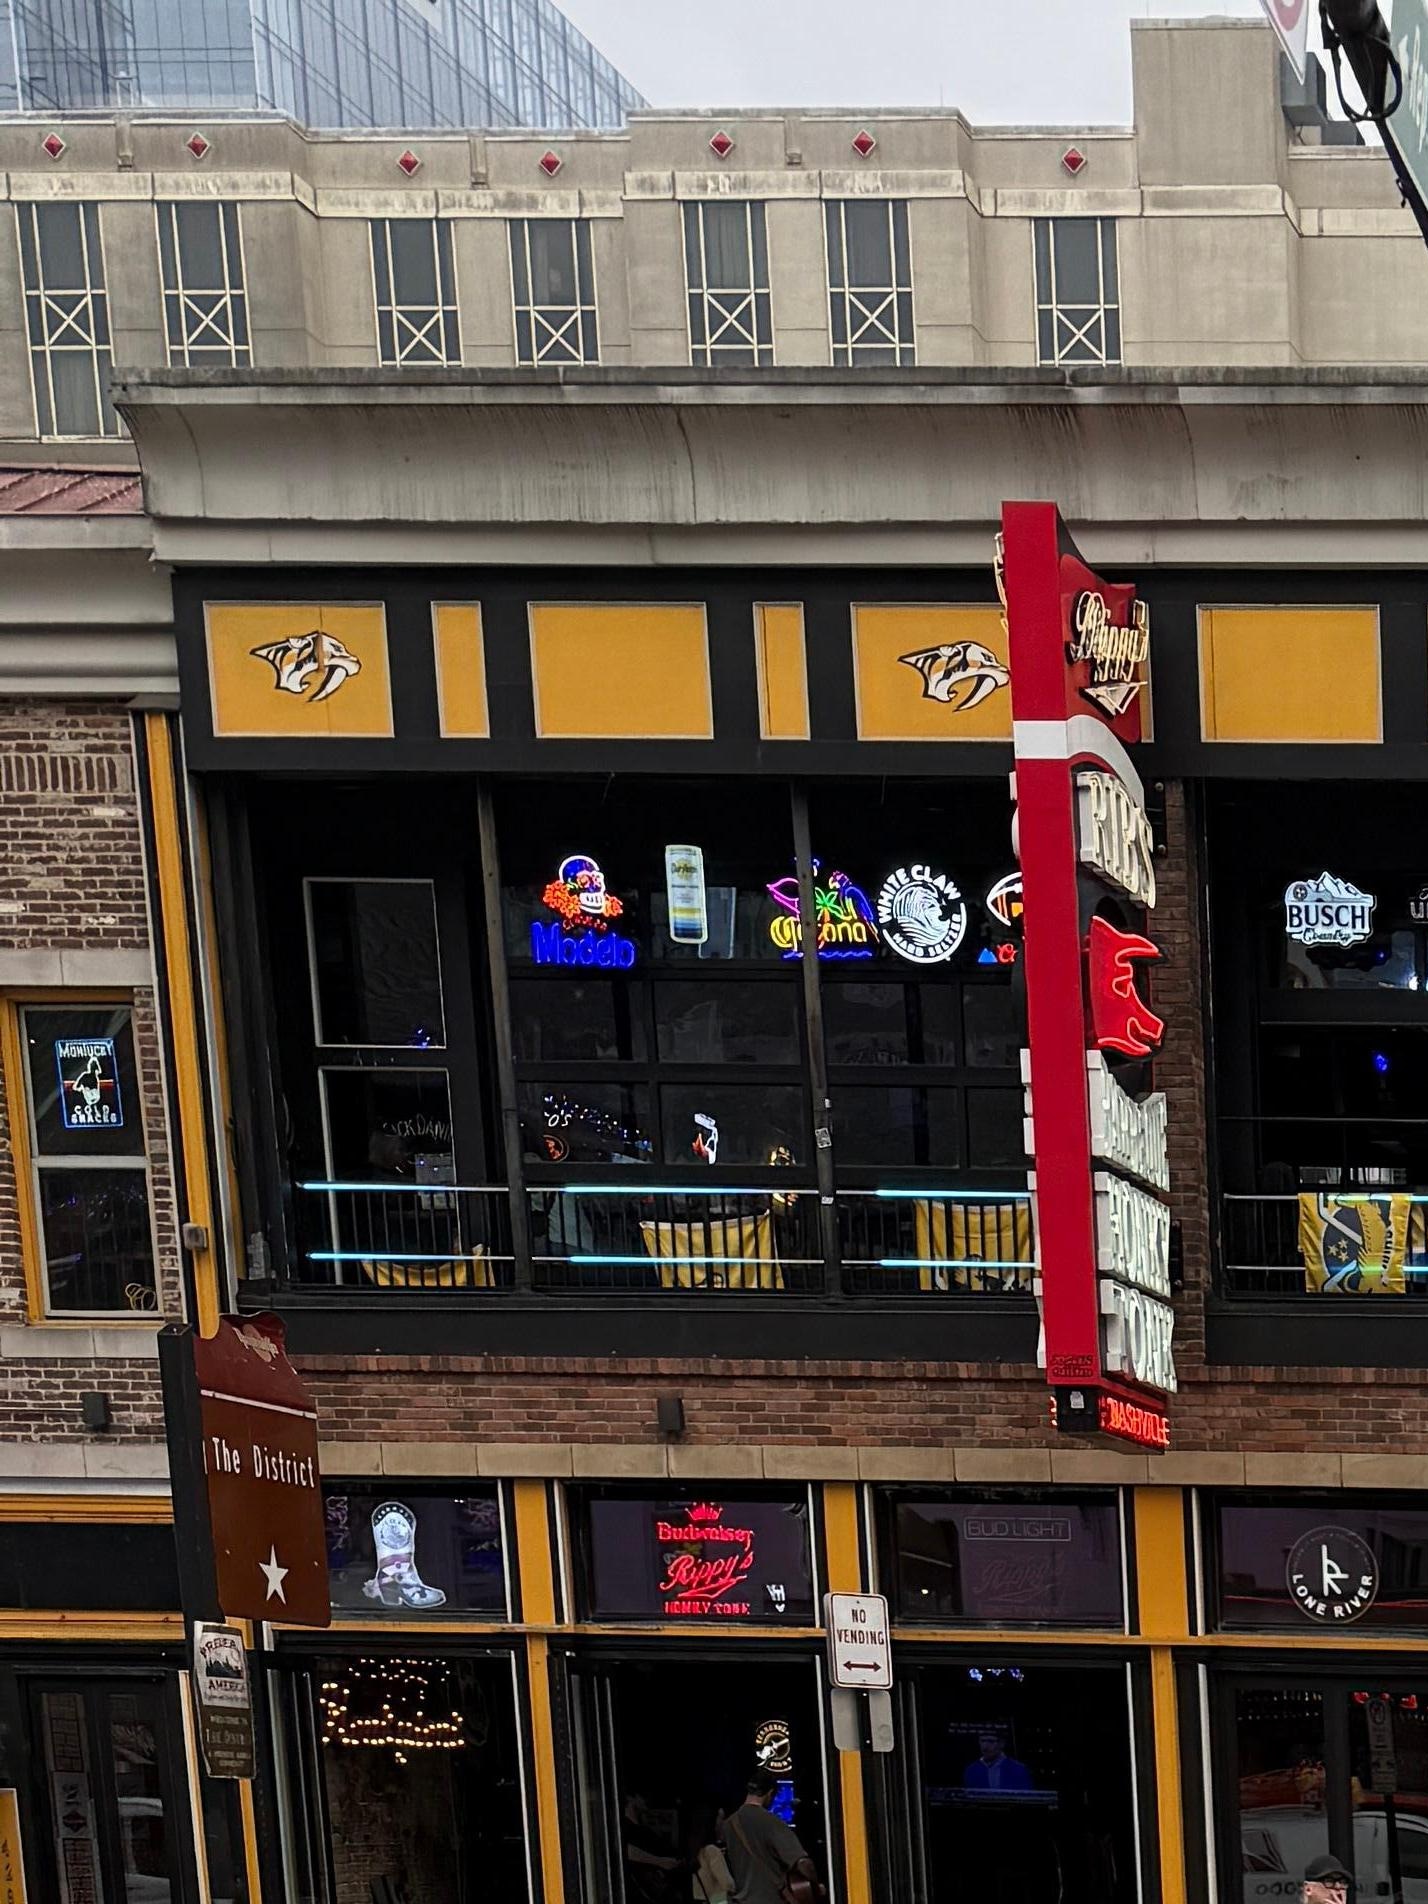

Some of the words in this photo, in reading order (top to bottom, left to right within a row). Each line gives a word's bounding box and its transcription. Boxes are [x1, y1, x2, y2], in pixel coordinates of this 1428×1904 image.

[878, 868, 909, 923] WHITE
[911, 864, 961, 900] CLAW
[1289, 903, 1366, 929] BUSCH
[532, 921, 636, 967] Modelo
[893, 932, 925, 957] HARD
[212, 1436, 241, 1475] The
[253, 1444, 315, 1489] District
[656, 1521, 754, 1551] Budweiser
[967, 1520, 1009, 1537] BUD
[1013, 1521, 1066, 1538] LIGHT
[659, 1551, 753, 1591] Rippy's
[1292, 1573, 1327, 1616] LONE
[1333, 1575, 1373, 1618] RIVER
[851, 1608, 867, 1624] NO
[836, 1628, 885, 1646] VENDING
